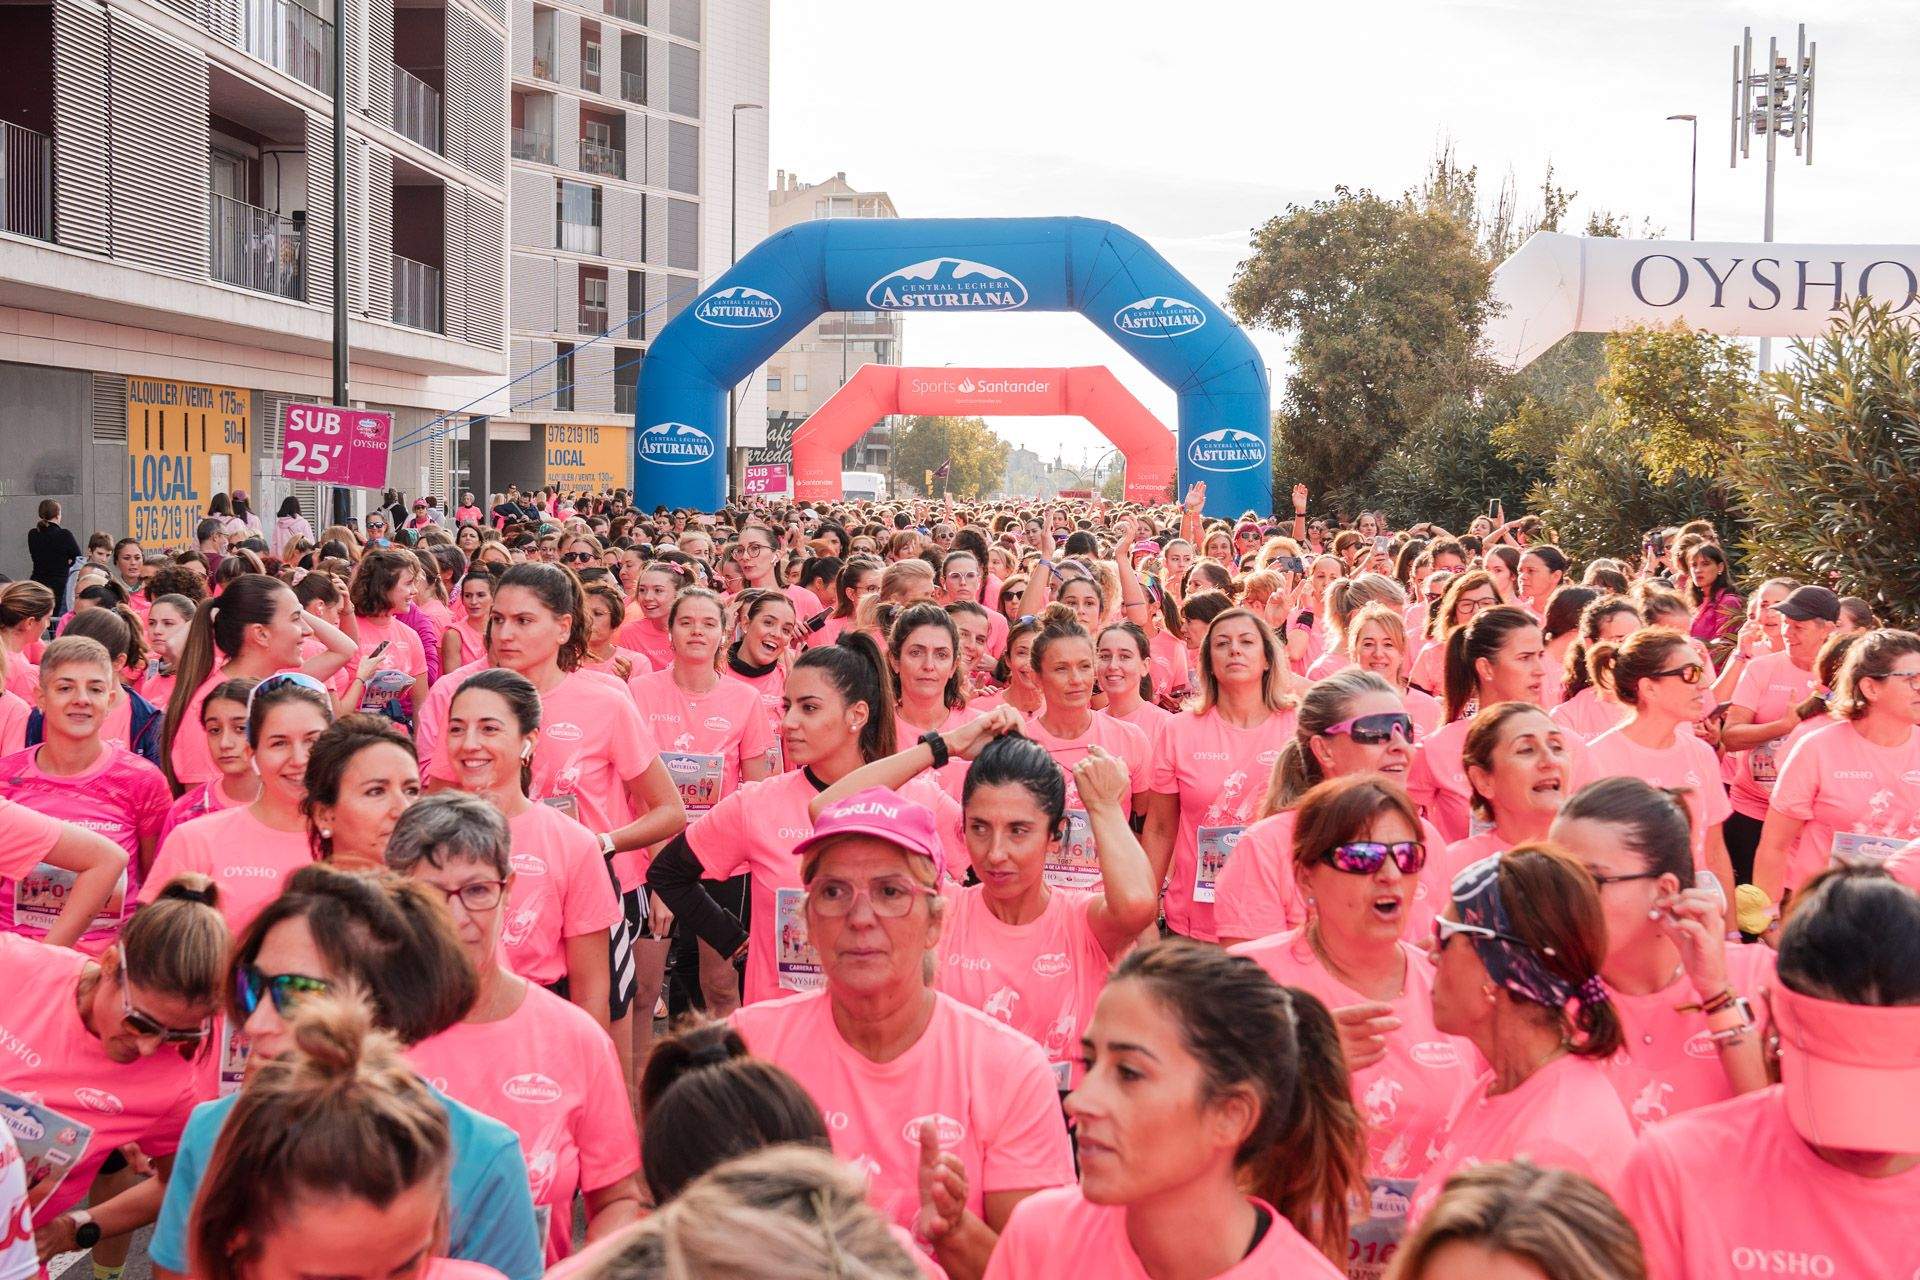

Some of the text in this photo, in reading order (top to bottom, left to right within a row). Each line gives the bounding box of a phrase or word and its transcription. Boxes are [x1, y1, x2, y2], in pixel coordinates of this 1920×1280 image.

[902, 281, 1010, 292] CENTRAL LECHERA
[1630, 253, 1919, 314] OYSHO
[881, 287, 1018, 308] ASTURIANA
[700, 302, 775, 318] ASTURIANA
[1122, 313, 1201, 329] ASTURIANA
[912, 379, 1050, 396] Sports Santander
[290, 409, 341, 435] SUB
[548, 425, 600, 444] 976 219 115
[353, 439, 387, 450] OYSHO
[641, 437, 709, 456] ASTURIANA
[1193, 444, 1263, 461] ASTURIANA
[284, 441, 343, 475] 25'
[547, 448, 586, 467] LOCAL
[130, 454, 198, 501] LOCAL
[747, 468, 768, 478] SUB
[136, 505, 159, 541] 976
[161, 505, 182, 540] 219
[778, 826, 815, 840] OYSH
[223, 865, 278, 879] OYSHO
[789, 964, 813, 972] CARRERA
[1731, 1246, 1836, 1279] OYSHO
